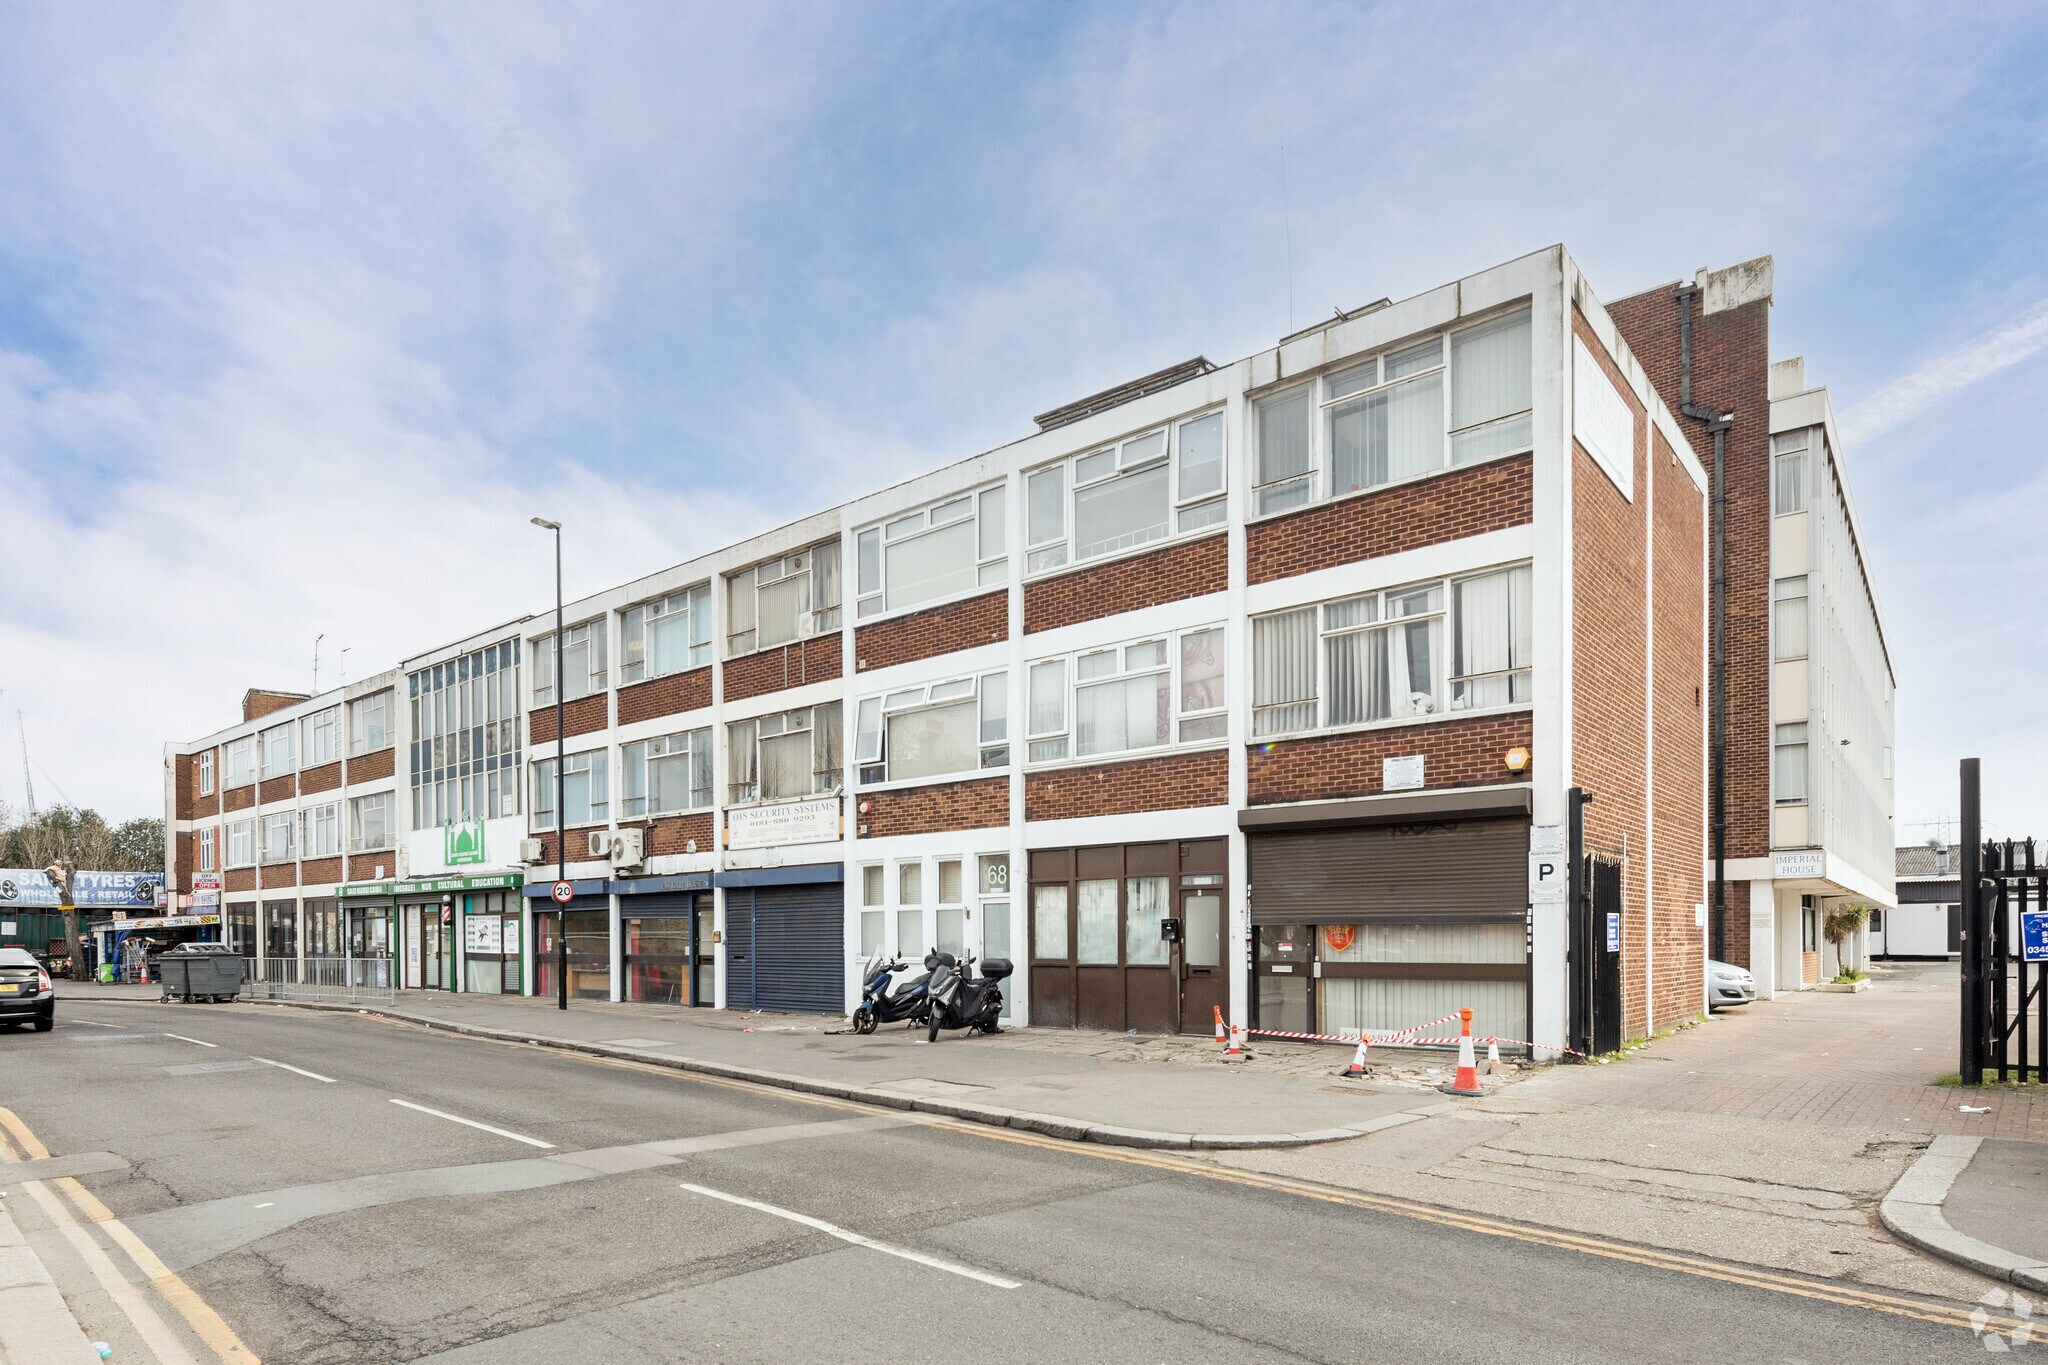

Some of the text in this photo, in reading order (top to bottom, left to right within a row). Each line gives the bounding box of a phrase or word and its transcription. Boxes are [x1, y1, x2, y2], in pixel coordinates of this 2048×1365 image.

[750, 807, 791, 819] SECURITY
[794, 802, 835, 814] SYSTEMS
[1776, 855, 1822, 864] IMPERIAL
[988, 865, 1007, 884] 68
[1539, 863, 1554, 881] P
[1782, 866, 1817, 874] HOUSE
[78, 873, 136, 888] TYRES
[438, 879, 464, 890] CULTURAL
[472, 877, 504, 887] EDUCATION
[20, 889, 136, 899] WHOLELE RETAIL
[557, 887, 571, 896] 20
